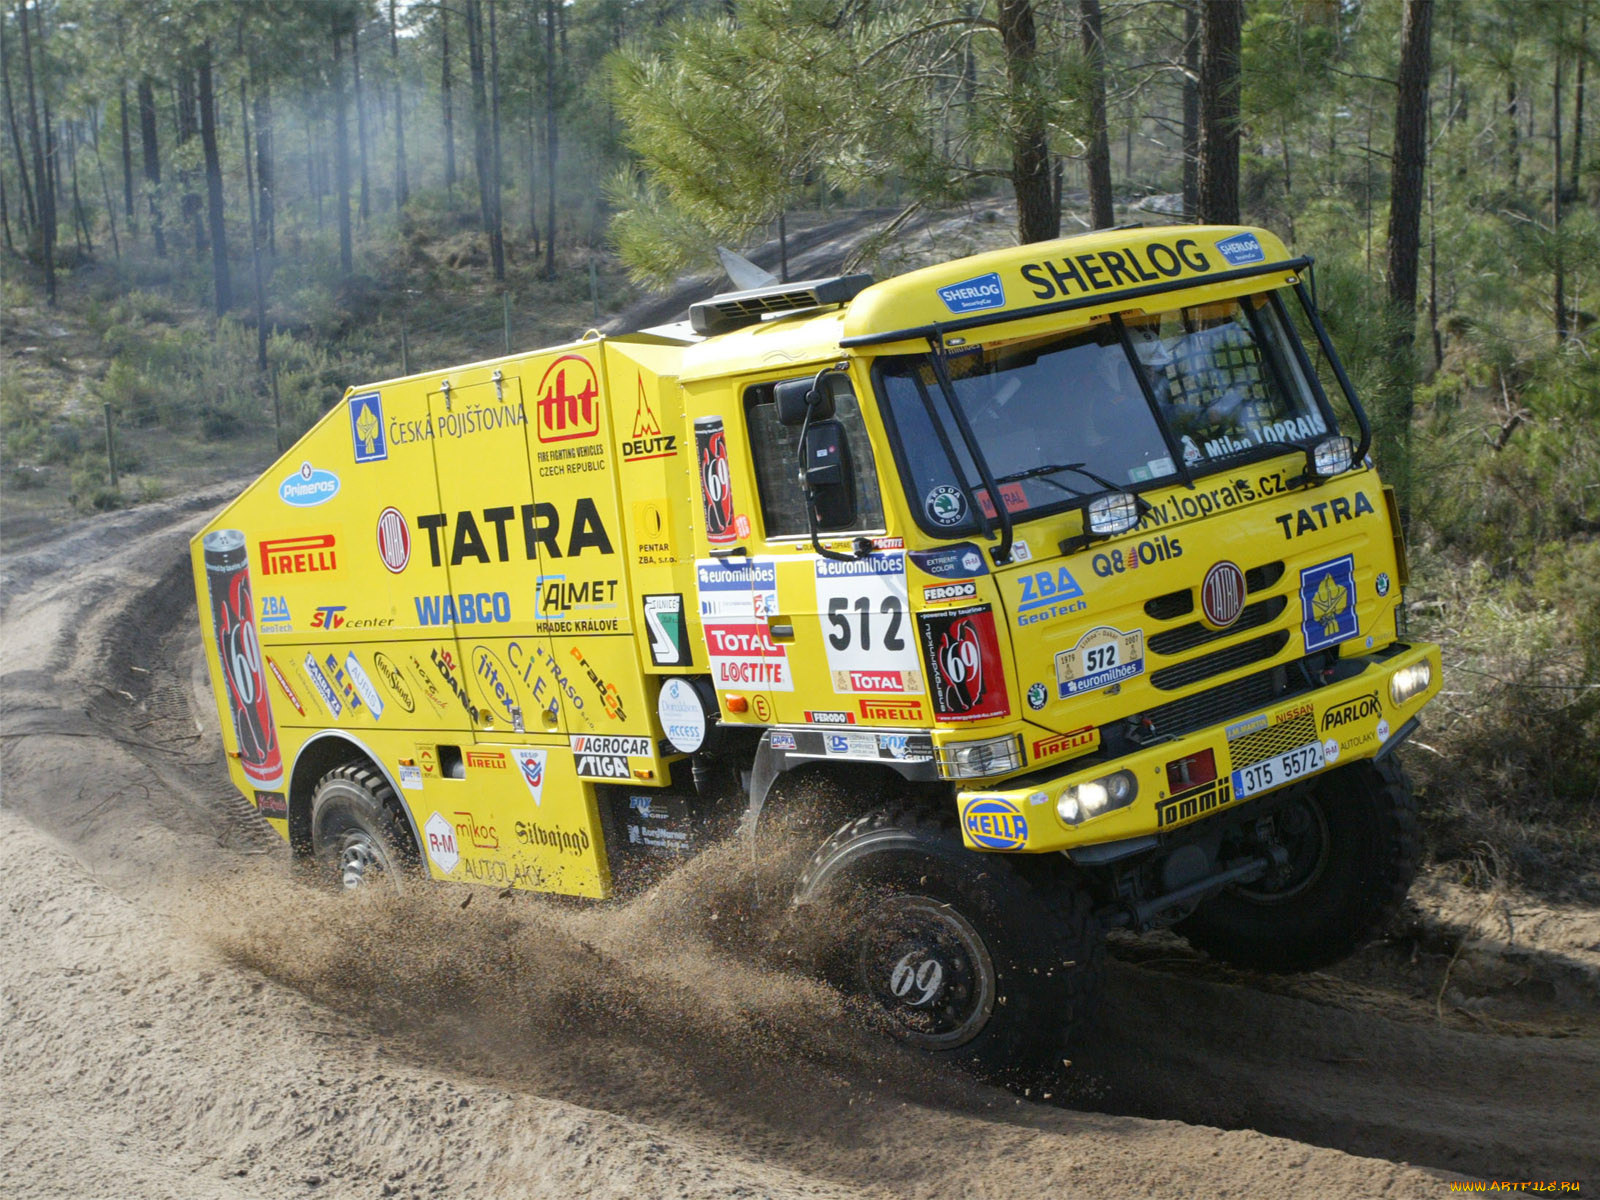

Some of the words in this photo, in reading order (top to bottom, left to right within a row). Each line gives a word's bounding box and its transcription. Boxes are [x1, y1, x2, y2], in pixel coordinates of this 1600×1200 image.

[1219, 240, 1259, 255] SHERLOG
[1019, 239, 1211, 300] SHERLOG
[942, 283, 1000, 302] SHERLOG
[389, 414, 436, 446] ČESKÁ
[437, 403, 529, 439] POJIŠŤOVNA
[537, 450, 549, 463] FIRE
[549, 447, 577, 462] FIGHTING
[576, 444, 604, 458] VEHICLES
[622, 435, 677, 457] DEUTZ
[1204, 435, 1252, 458] Milan
[539, 465, 566, 478] CZECH
[566, 460, 606, 474] REPUBLIC
[283, 480, 336, 499] Primeros
[1276, 490, 1375, 540] TATRA
[416, 497, 615, 568] TATRA
[258, 533, 337, 576] PIRELLI
[639, 543, 670, 553] PENTAR
[1092, 550, 1126, 578] Q8
[1137, 533, 1183, 561] Oils
[708, 566, 774, 583] euromilhões
[827, 555, 904, 576] euromilhões
[931, 564, 955, 574] COLOR
[542, 579, 619, 612] ALMET
[923, 583, 976, 600] FERODO
[1017, 566, 1084, 604] ZBA
[414, 591, 512, 626] WABCO
[1017, 600, 1088, 627] GeoTech
[345, 618, 395, 629] center
[536, 620, 573, 633] HRADEC
[574, 617, 619, 632] KRÁLOVÉ
[827, 595, 906, 652] 512
[710, 629, 777, 652] TOTAL
[946, 640, 979, 684] 69
[1087, 645, 1116, 672] 512
[545, 654, 584, 710] TRASO
[570, 646, 628, 722] prabos
[720, 662, 782, 683] LOCTITE
[850, 673, 904, 690] TOTAL
[1077, 663, 1137, 690] euromilhões
[430, 647, 479, 726] LOANA
[756, 700, 767, 717] E
[812, 711, 847, 724] FERODO
[858, 699, 924, 721] PIRELLI
[1275, 703, 1314, 724] NISSAN
[1324, 697, 1381, 731] PARLOK
[669, 724, 700, 738] ACCESS
[1032, 724, 1095, 760] PIRELLI
[1340, 732, 1376, 751] AUTOLAKY
[583, 737, 650, 756] AGROCAR
[465, 751, 507, 769] PIRELLI
[577, 755, 630, 778] STIGA
[1244, 762, 1273, 792] 3T5
[1281, 746, 1319, 778] 5572
[514, 820, 590, 857] Silvajagd
[967, 814, 1029, 842] HELLA
[428, 832, 455, 854] R-M
[464, 858, 544, 888] AUTOLAKY
[889, 950, 943, 1007] 69
